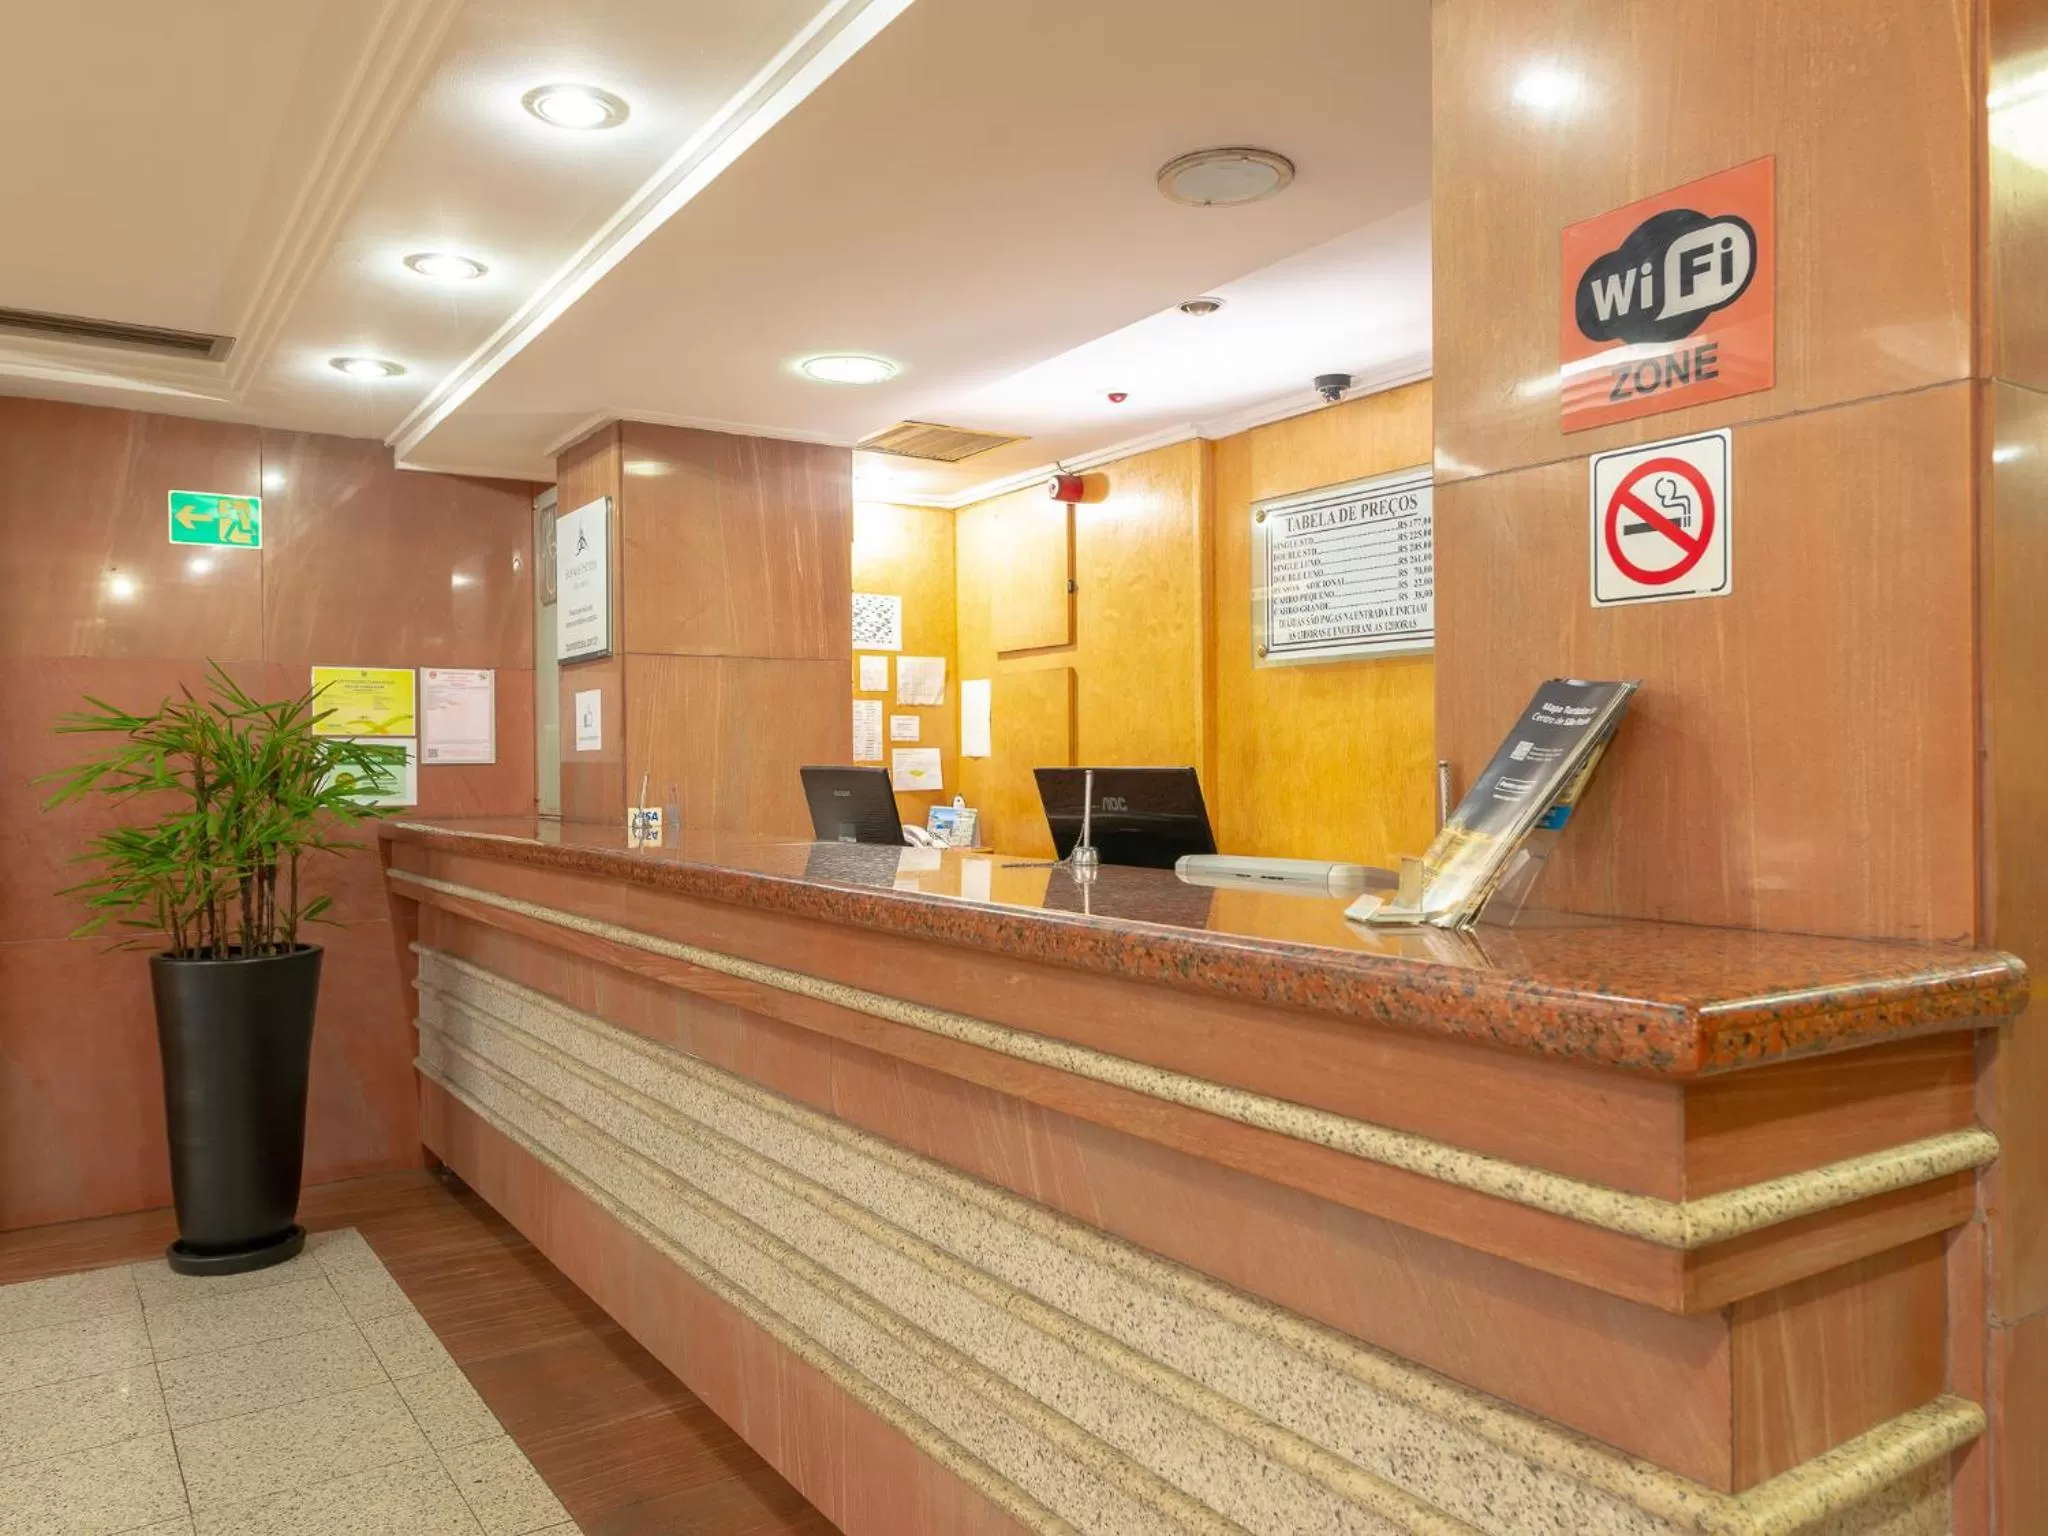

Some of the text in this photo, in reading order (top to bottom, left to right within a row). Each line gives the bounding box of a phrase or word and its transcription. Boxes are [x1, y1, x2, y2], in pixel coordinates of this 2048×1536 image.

[1609, 342, 1719, 401] ZONE
[1286, 493, 1418, 531] TABELA DE PREÇOS
